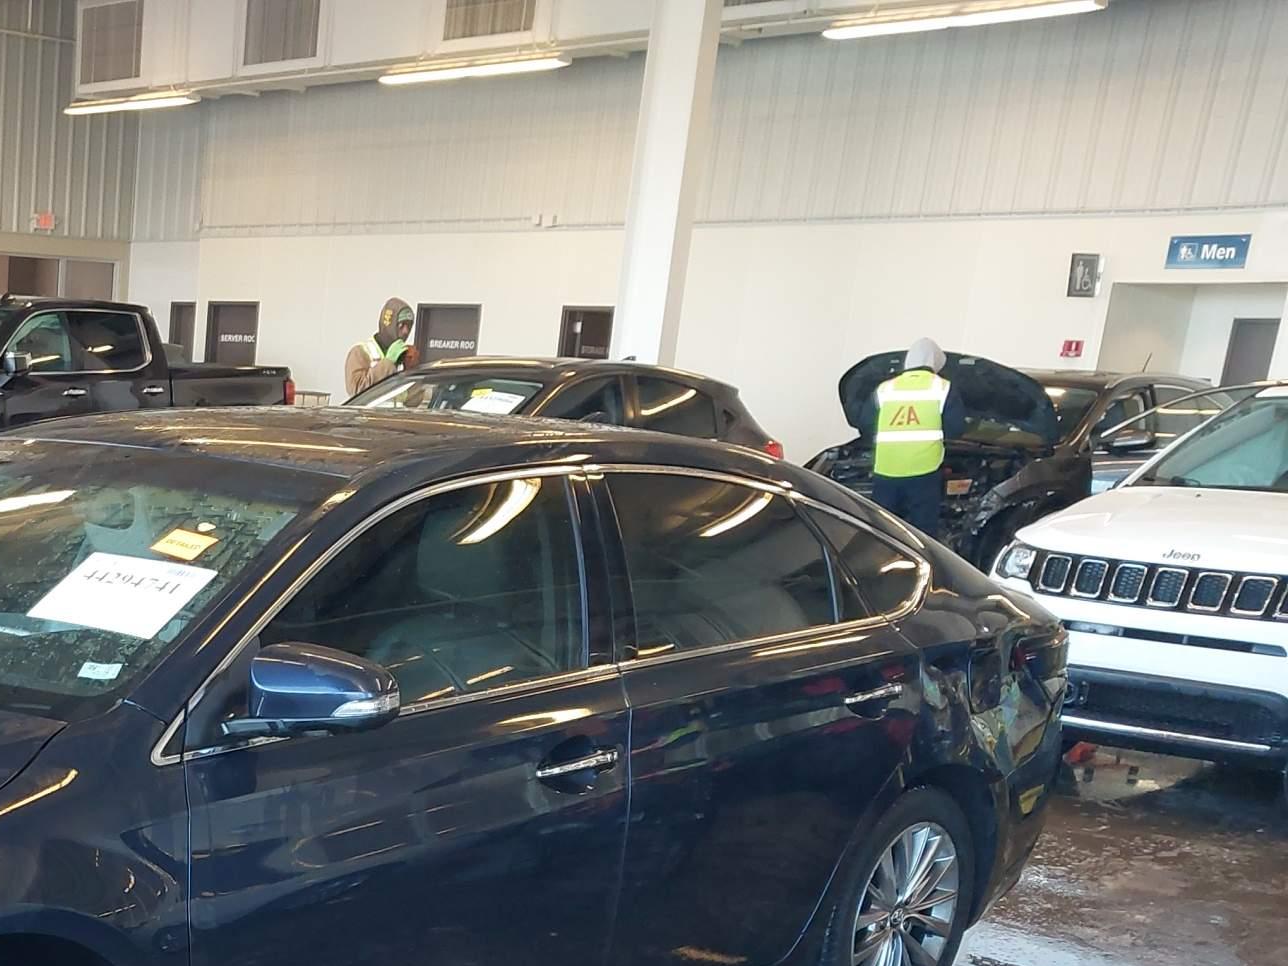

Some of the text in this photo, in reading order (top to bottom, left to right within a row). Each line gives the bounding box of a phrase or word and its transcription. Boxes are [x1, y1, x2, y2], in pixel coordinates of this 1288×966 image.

[1200, 243, 1237, 260] Men
[220, 333, 243, 343] SERVER
[429, 339, 459, 349] BREAKER
[1162, 548, 1201, 562] Jeep
